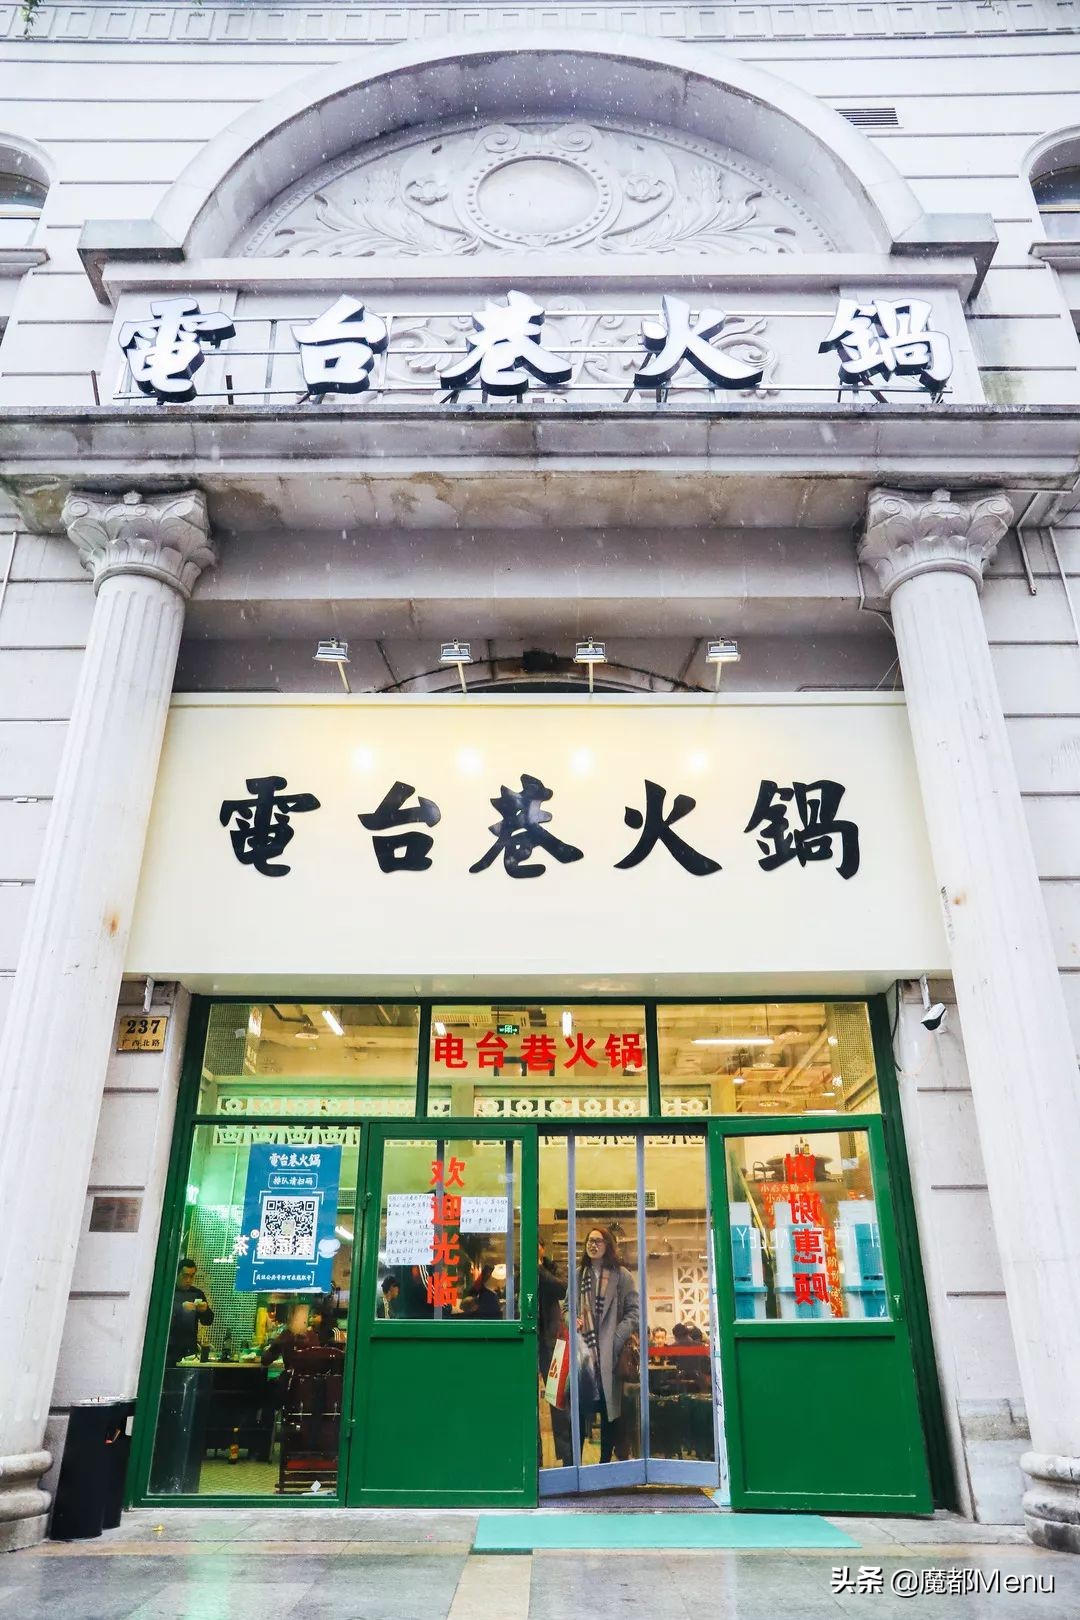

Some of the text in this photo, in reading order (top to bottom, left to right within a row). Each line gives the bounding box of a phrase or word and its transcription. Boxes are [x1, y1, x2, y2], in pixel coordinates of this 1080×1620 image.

[118, 288, 954, 402] 電台巷火鍋
[219, 773, 861, 881] 電台巷火鍋
[125, 1019, 161, 1034] 237
[434, 1030, 644, 1072] 电台巷火锅
[273, 1175, 314, 1187] 排队请扫码
[426, 1156, 466, 1308] 欢迎光临
